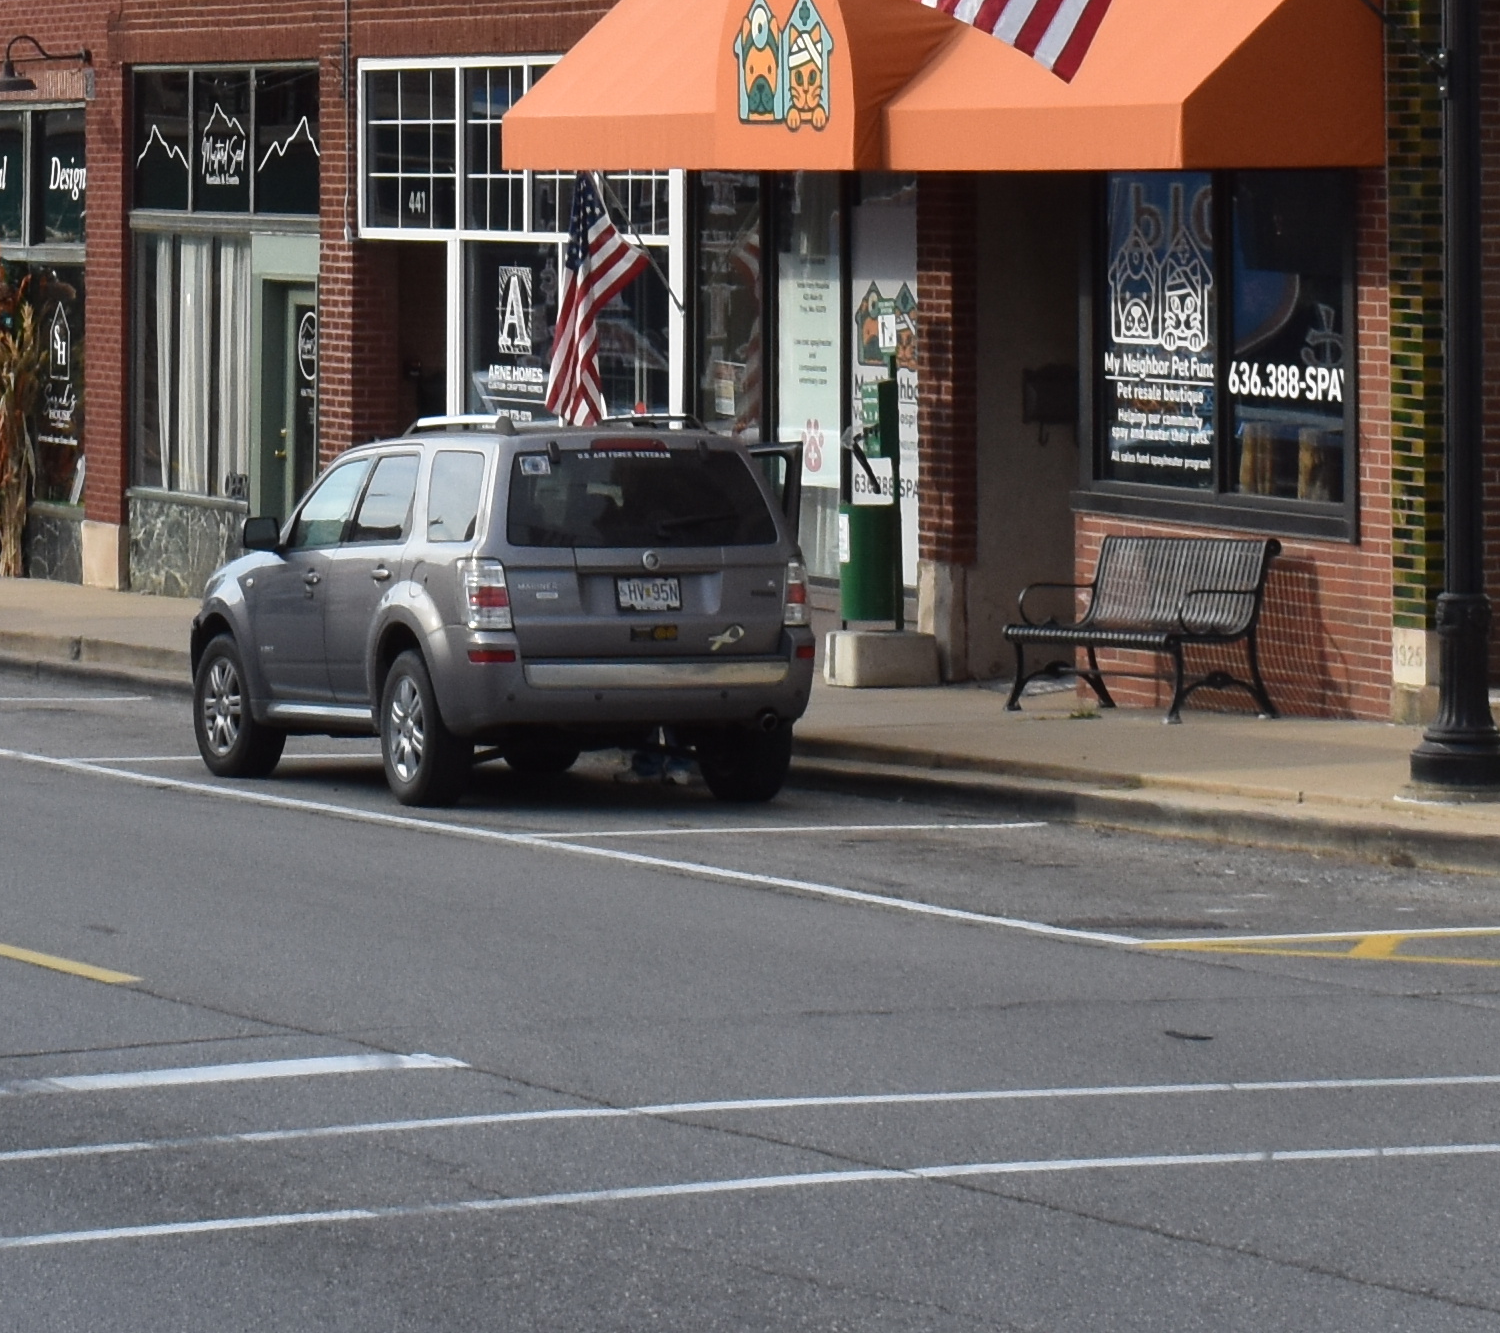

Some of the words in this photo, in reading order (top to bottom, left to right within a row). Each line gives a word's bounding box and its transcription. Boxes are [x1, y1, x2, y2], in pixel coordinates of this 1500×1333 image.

[49, 156, 86, 201] Design
[408, 190, 426, 213] 441
[488, 364, 512, 381] ARNE
[512, 365, 543, 383] HOMES
[1104, 352, 1120, 375] My
[1122, 353, 1169, 378] Neighbor
[1171, 356, 1189, 377] Pet
[1117, 382, 1132, 399] Pet
[1133, 384, 1162, 401] resale
[1163, 386, 1204, 408] boutique
[48, 409, 71, 421] HOUSE
[1118, 408, 1147, 427] Helping
[1148, 413, 1161, 425] our
[1162, 413, 1203, 431] community
[1111, 426, 1129, 441] spay
[1130, 425, 1145, 439] and
[1145, 429, 1170, 441] neuter
[1171, 428, 1189, 442] their
[593, 451, 606, 459] AIR
[608, 451, 632, 459] FORCE
[634, 451, 672, 459] VETERAN
